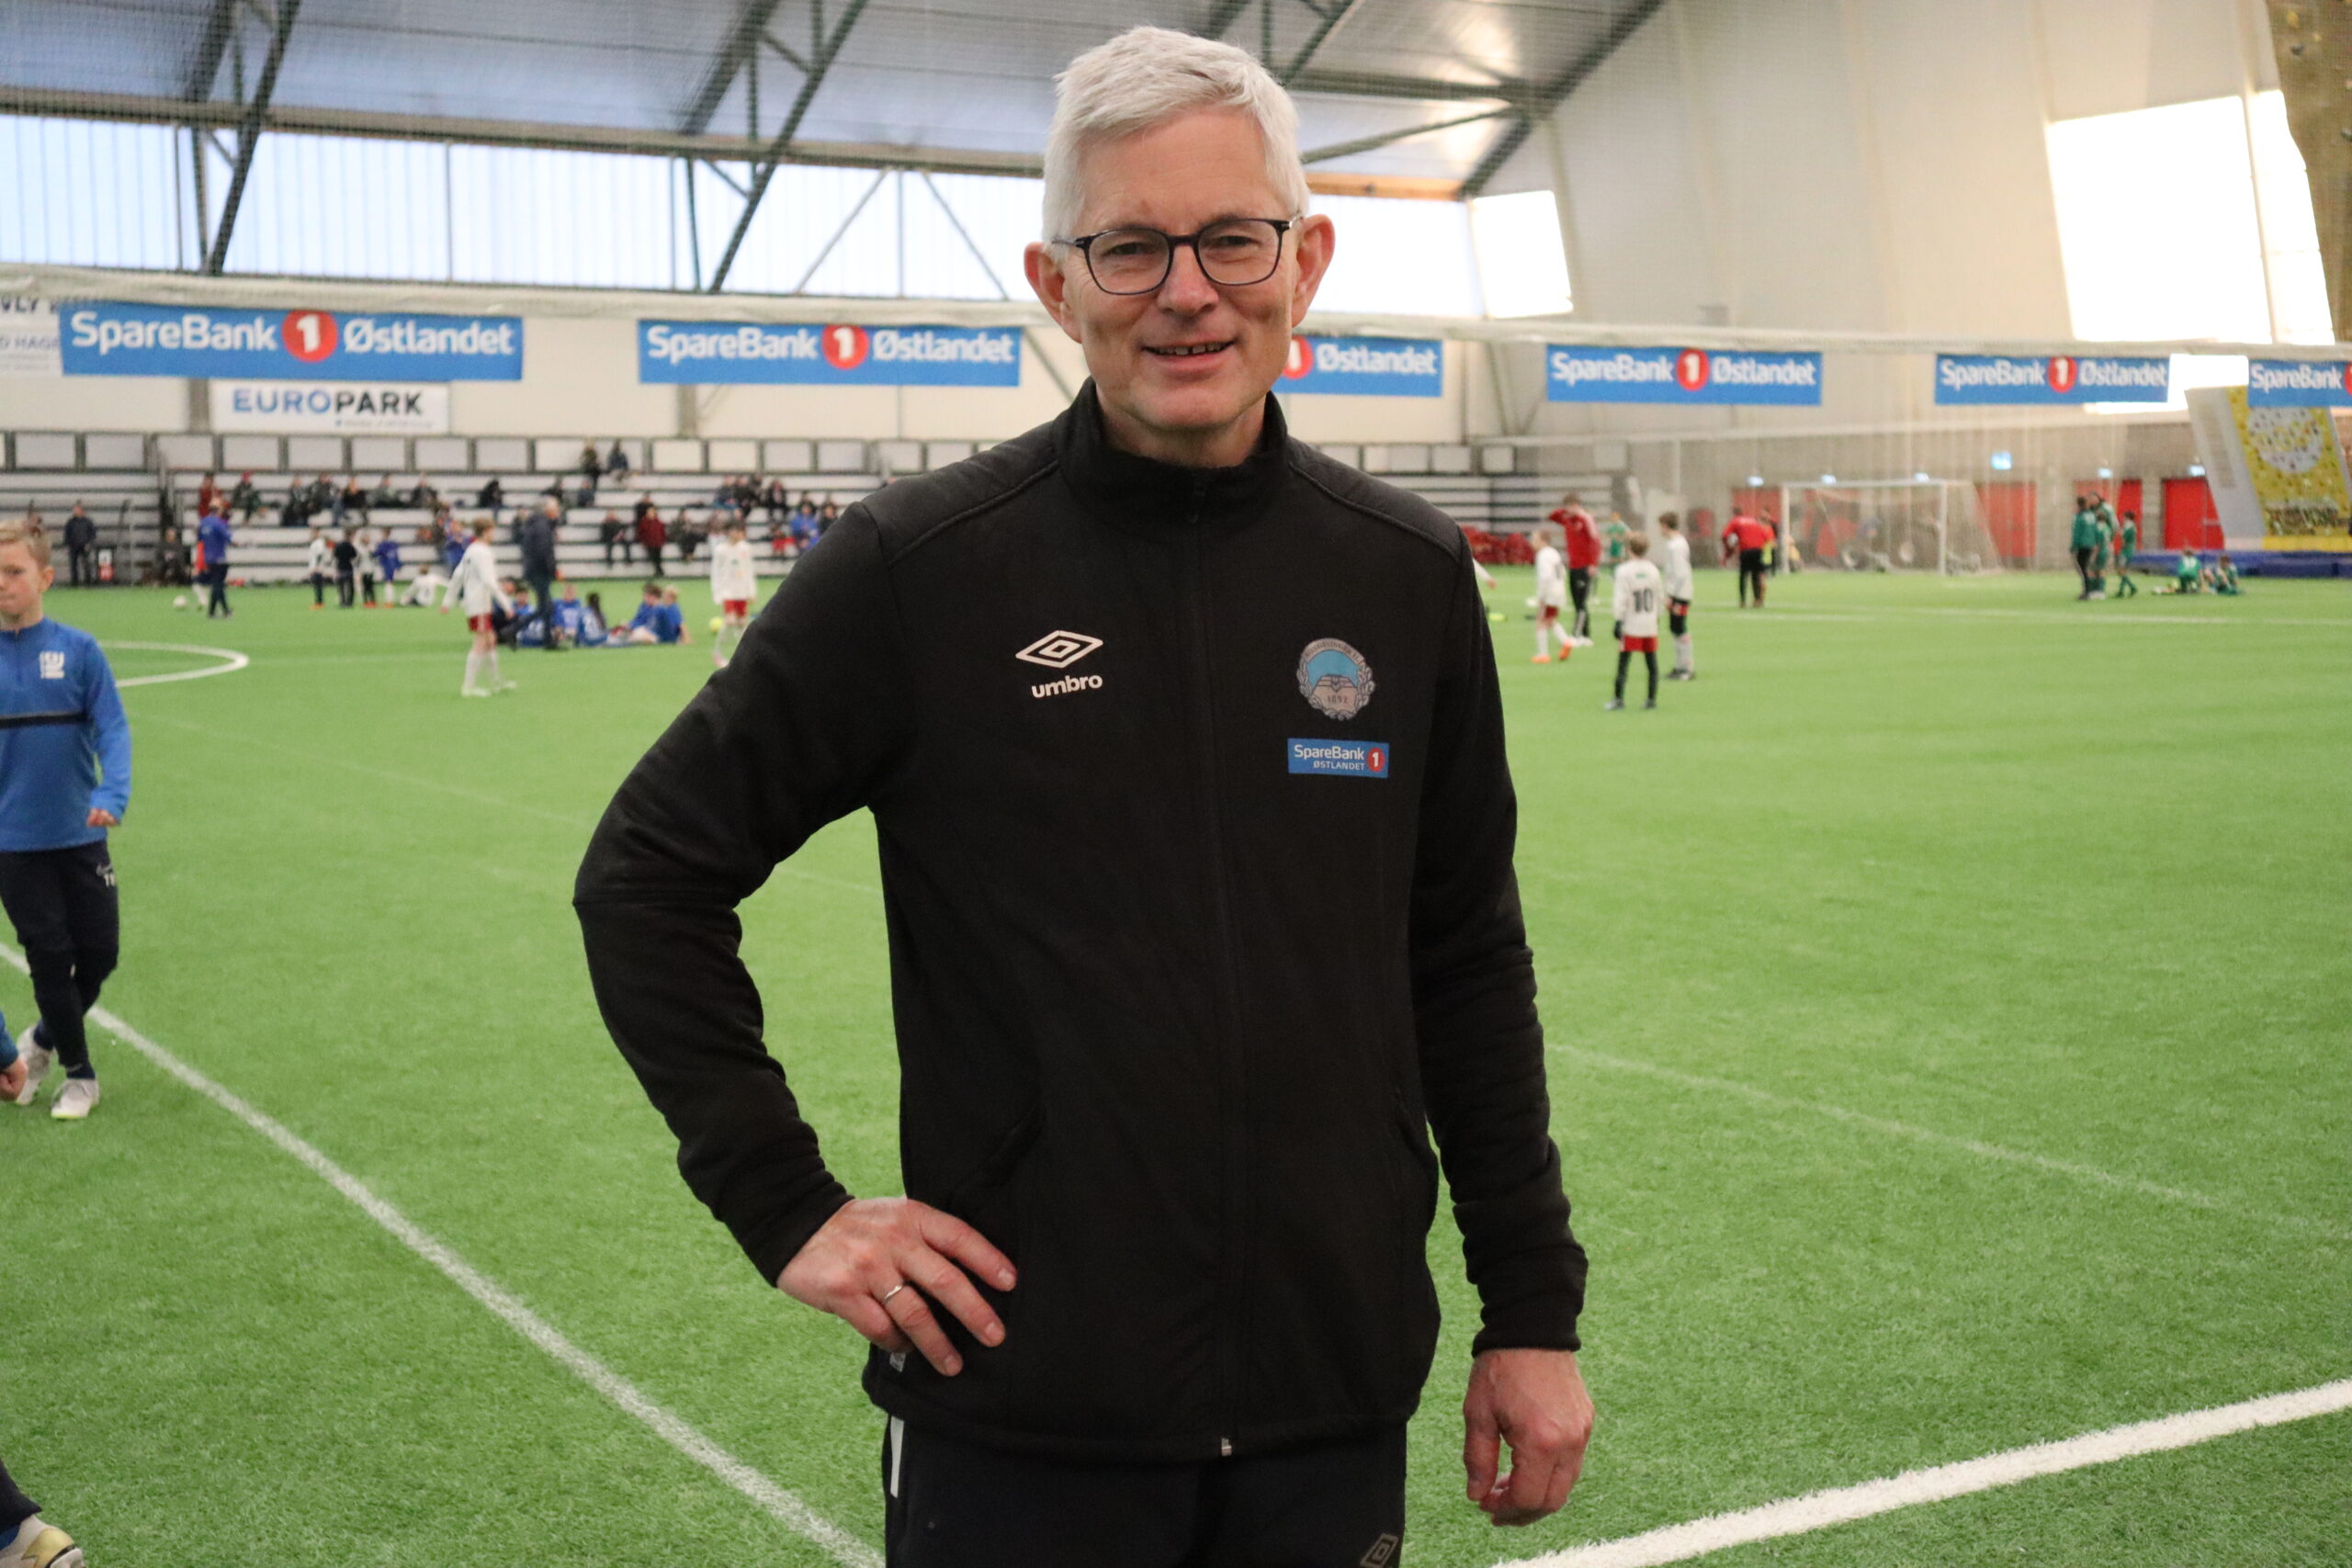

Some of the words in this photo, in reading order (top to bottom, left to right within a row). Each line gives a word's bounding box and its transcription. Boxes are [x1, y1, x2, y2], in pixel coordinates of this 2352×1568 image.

[71, 310, 277, 355] SpareBank
[297, 314, 321, 354] 1
[344, 318, 515, 355] Østlandet
[647, 325, 819, 365] SpareBank
[833, 326, 855, 362] 1
[873, 329, 1014, 362] Østlandet
[1316, 343, 1439, 374] Østlandet
[1551, 352, 1675, 386] SpareBank
[1685, 353, 1700, 383] 1
[1713, 356, 1816, 385] Østlandet
[1940, 359, 2046, 391] SpareBank
[2054, 358, 2068, 386] 1
[2079, 360, 2167, 387] Østlandet
[2251, 363, 2342, 395] SpareBank
[232, 389, 423, 415] EUROPARK
[1633, 588, 1654, 613] 10
[1031, 674, 1103, 699] umbro
[1294, 744, 1365, 761] SpareBank
[1372, 751, 1380, 768] 1
[1313, 761, 1365, 771] ØSTLANDET
